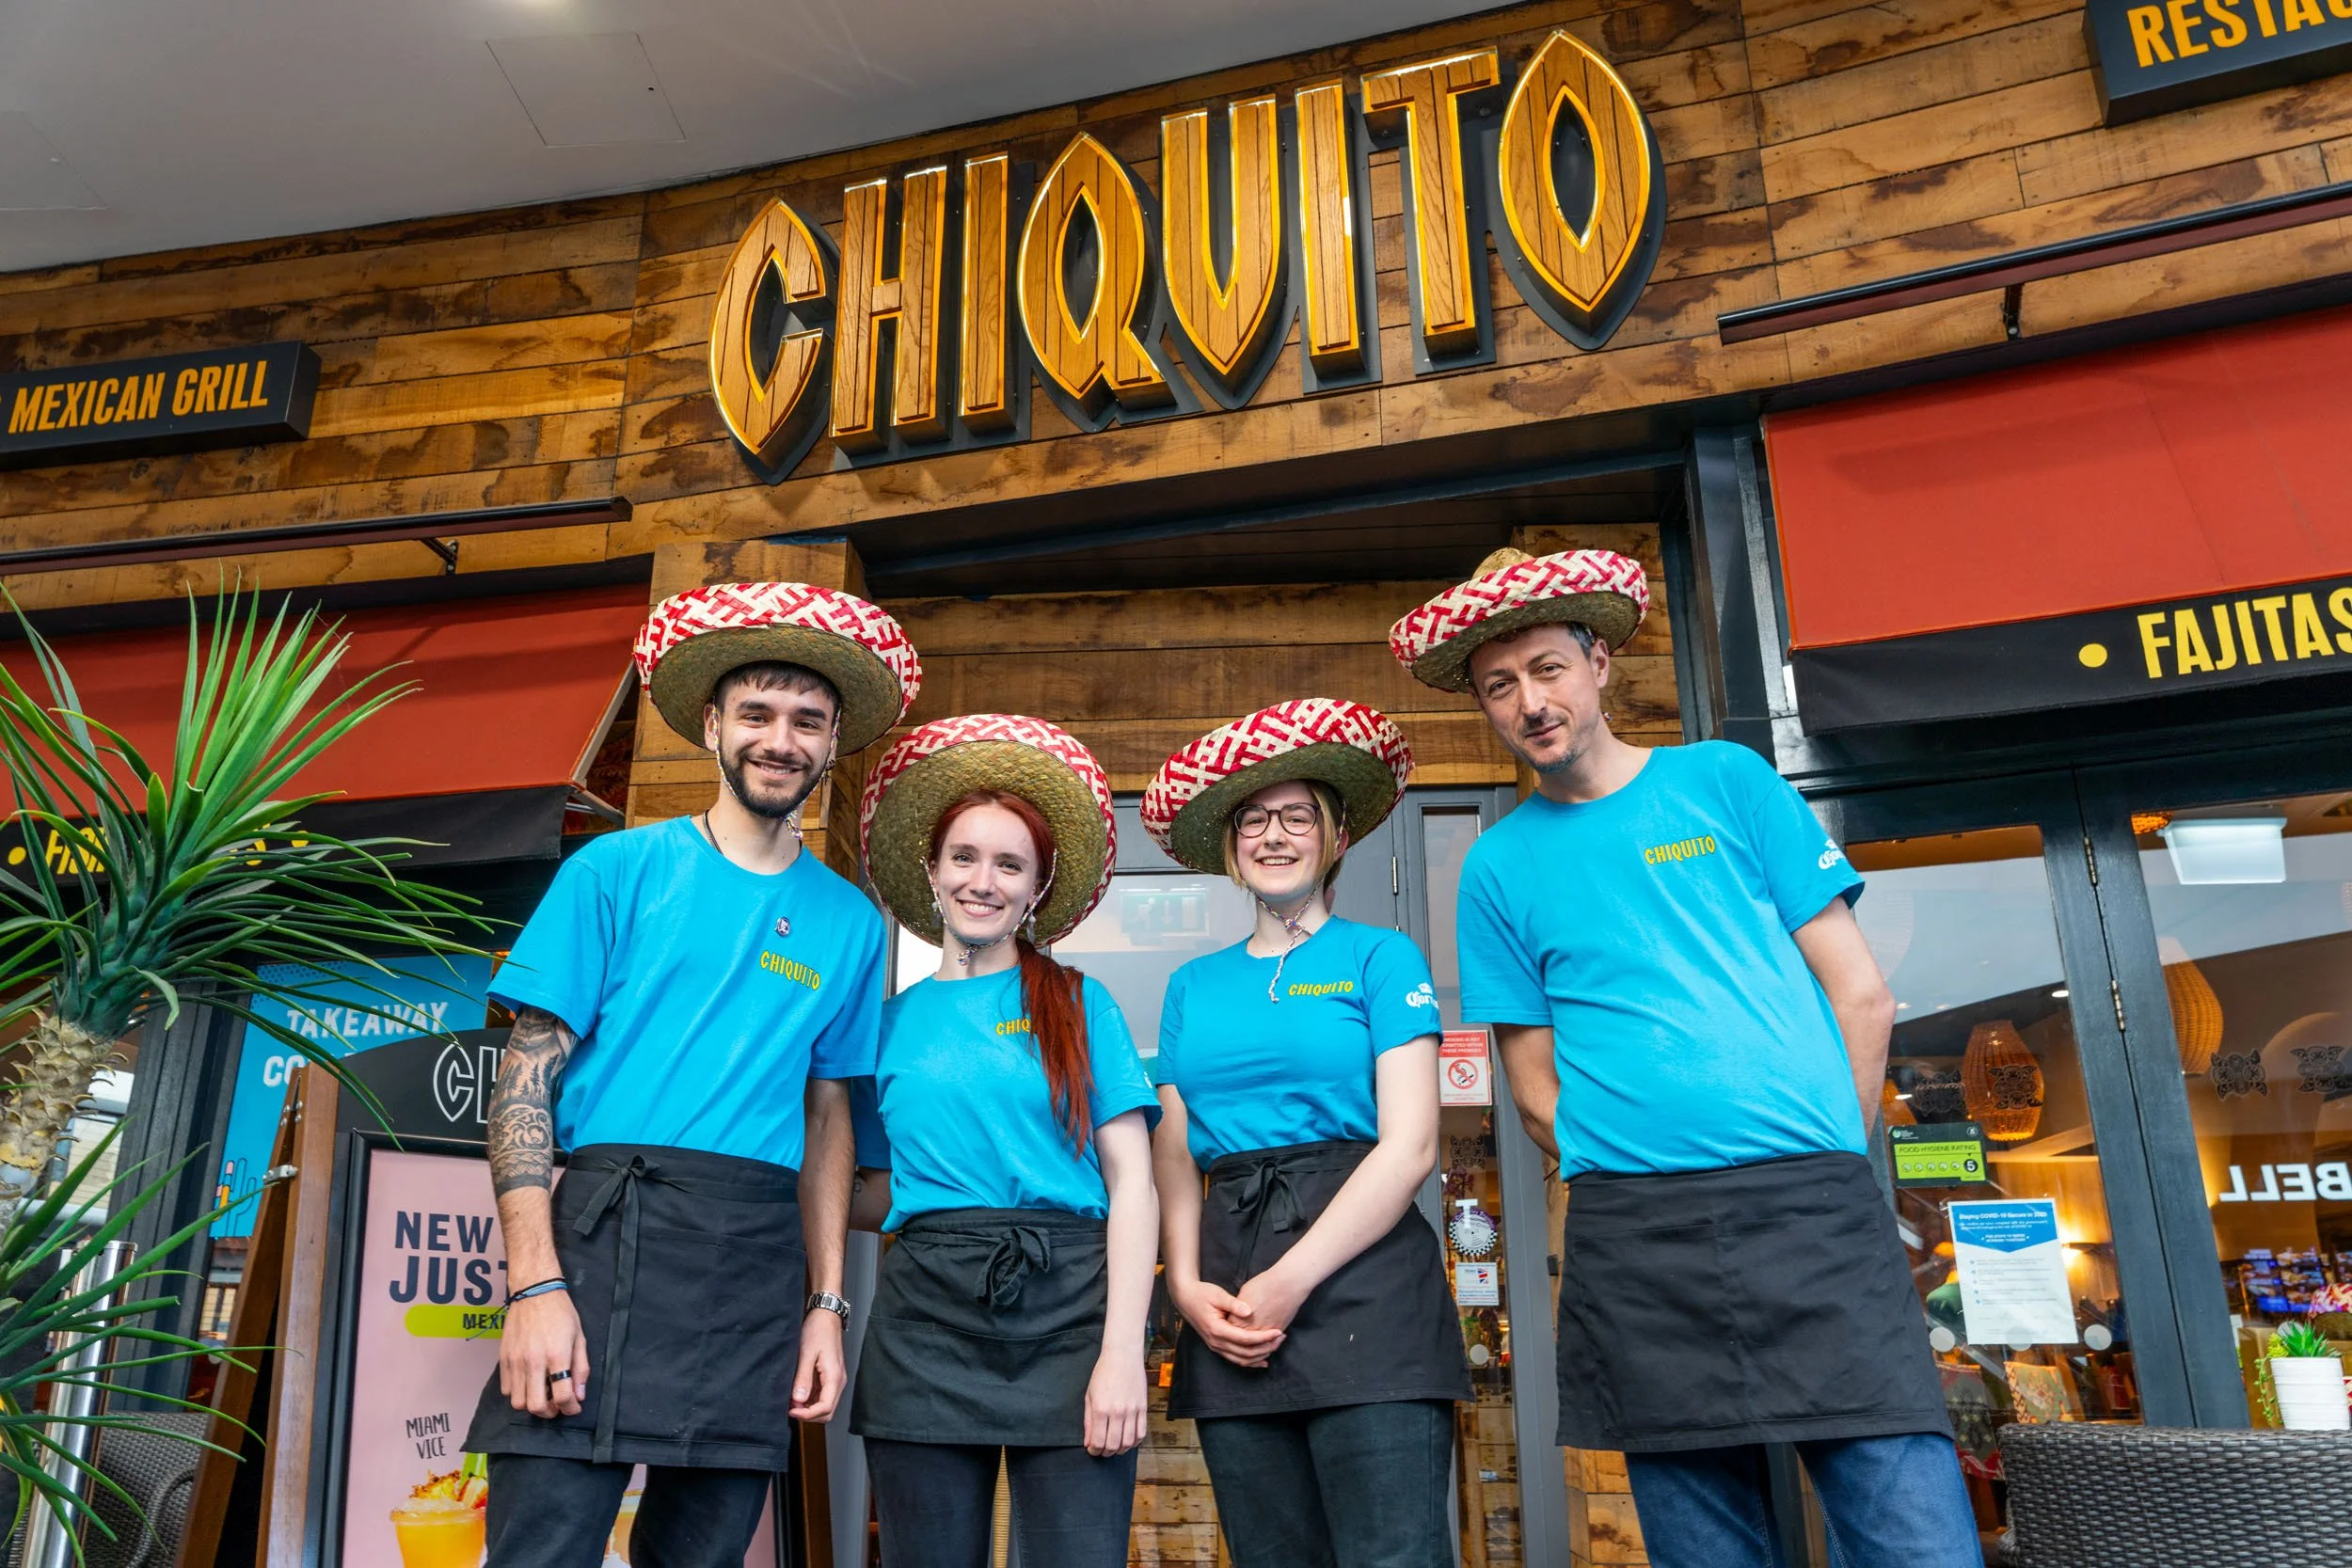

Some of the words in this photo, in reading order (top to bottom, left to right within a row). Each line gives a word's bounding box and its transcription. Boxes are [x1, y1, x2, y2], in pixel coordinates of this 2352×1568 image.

[2127, 0, 2352, 68] RESTA
[709, 30, 1653, 461] CHIQUITO
[8, 372, 166, 434] MEXICAN
[172, 360, 268, 416] GRILL
[1645, 835, 1715, 865] CHIQUITO
[760, 949, 820, 990] CHIQUITO
[1288, 980, 1355, 997] CHIQUITO
[286, 1002, 449, 1038] TAKEAWAY
[995, 1018, 1031, 1037] CHIQ
[1966, 1161, 1976, 1171] 5
[395, 1211, 494, 1253] NEW
[463, 1313, 505, 1330] MEXI
[405, 1413, 451, 1438] MIAMI
[416, 1436, 447, 1459] VICE
